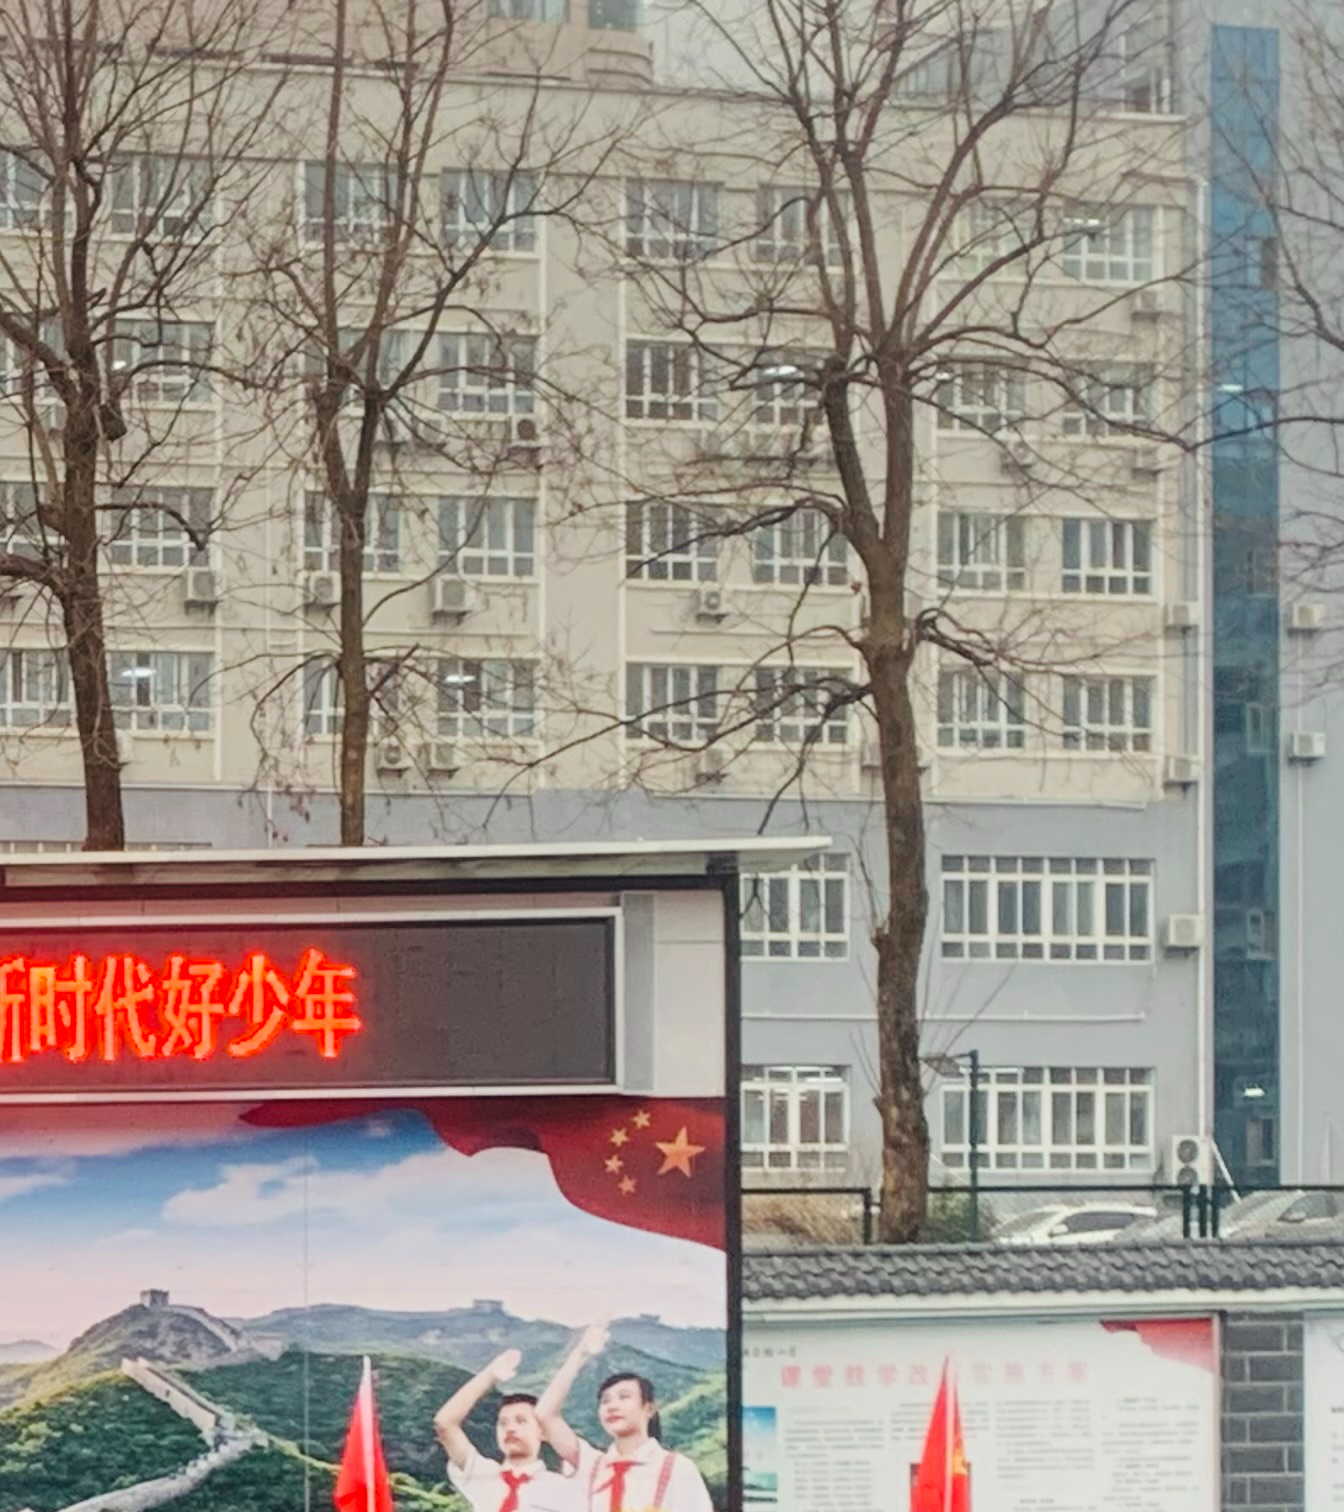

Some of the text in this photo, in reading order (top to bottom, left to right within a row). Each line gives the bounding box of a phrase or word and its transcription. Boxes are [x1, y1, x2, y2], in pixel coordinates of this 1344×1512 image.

[780, 1350, 1088, 1389] 课堂教学改实施方案
